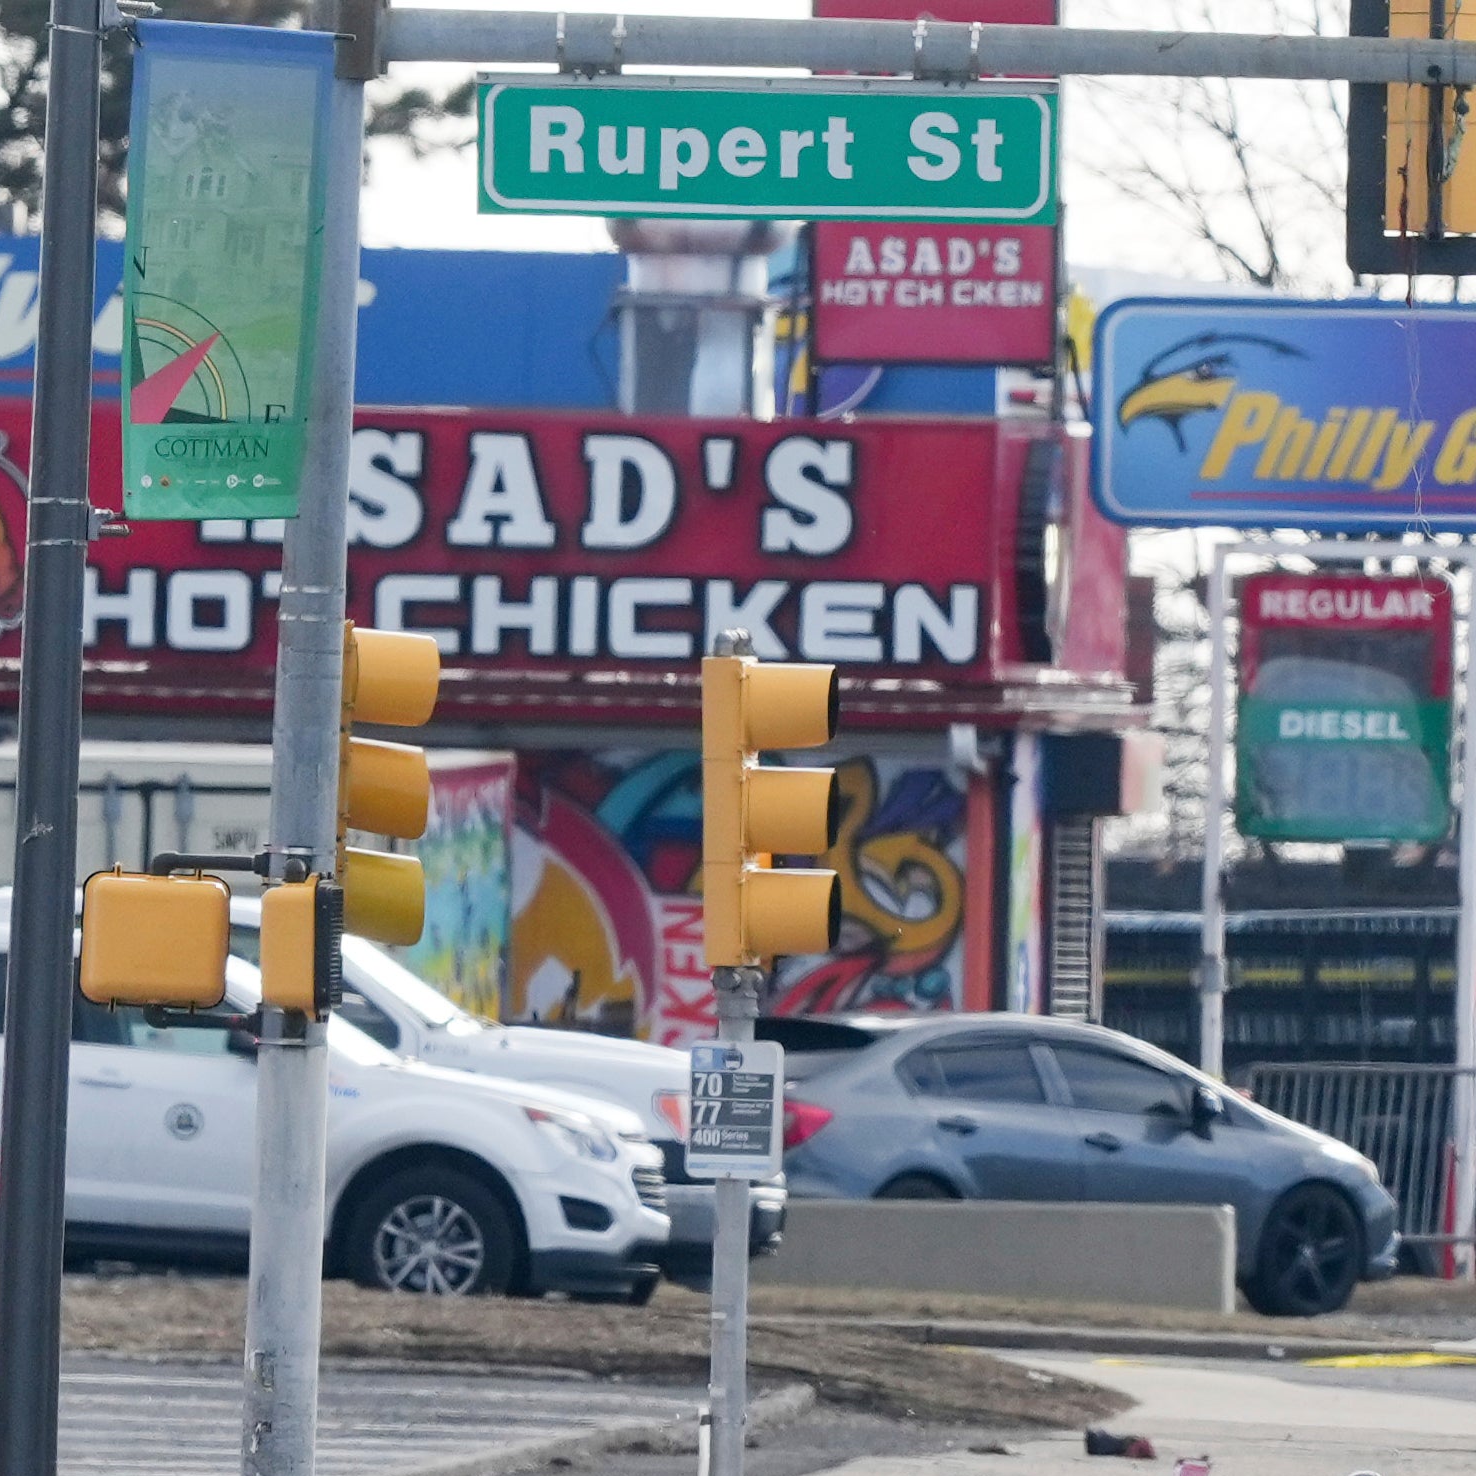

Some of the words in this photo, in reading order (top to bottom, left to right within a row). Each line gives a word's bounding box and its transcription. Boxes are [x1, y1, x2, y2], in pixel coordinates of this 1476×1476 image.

[530, 105, 855, 190] Rupert
[907, 111, 1004, 181] St
[844, 235, 1022, 277] ASAD'S
[820, 279, 891, 307] HOT
[155, 438, 270, 458] COTTMAN
[1200, 391, 1434, 491] Philly
[200, 428, 856, 558] SAD'S
[375, 574, 980, 664] CHICKEN
[1259, 590, 1434, 620] REGULAR
[1279, 710, 1411, 742] DIESEL
[693, 1073, 723, 1098] 70
[693, 1101, 722, 1126] 77
[691, 1130, 721, 1147] 400
